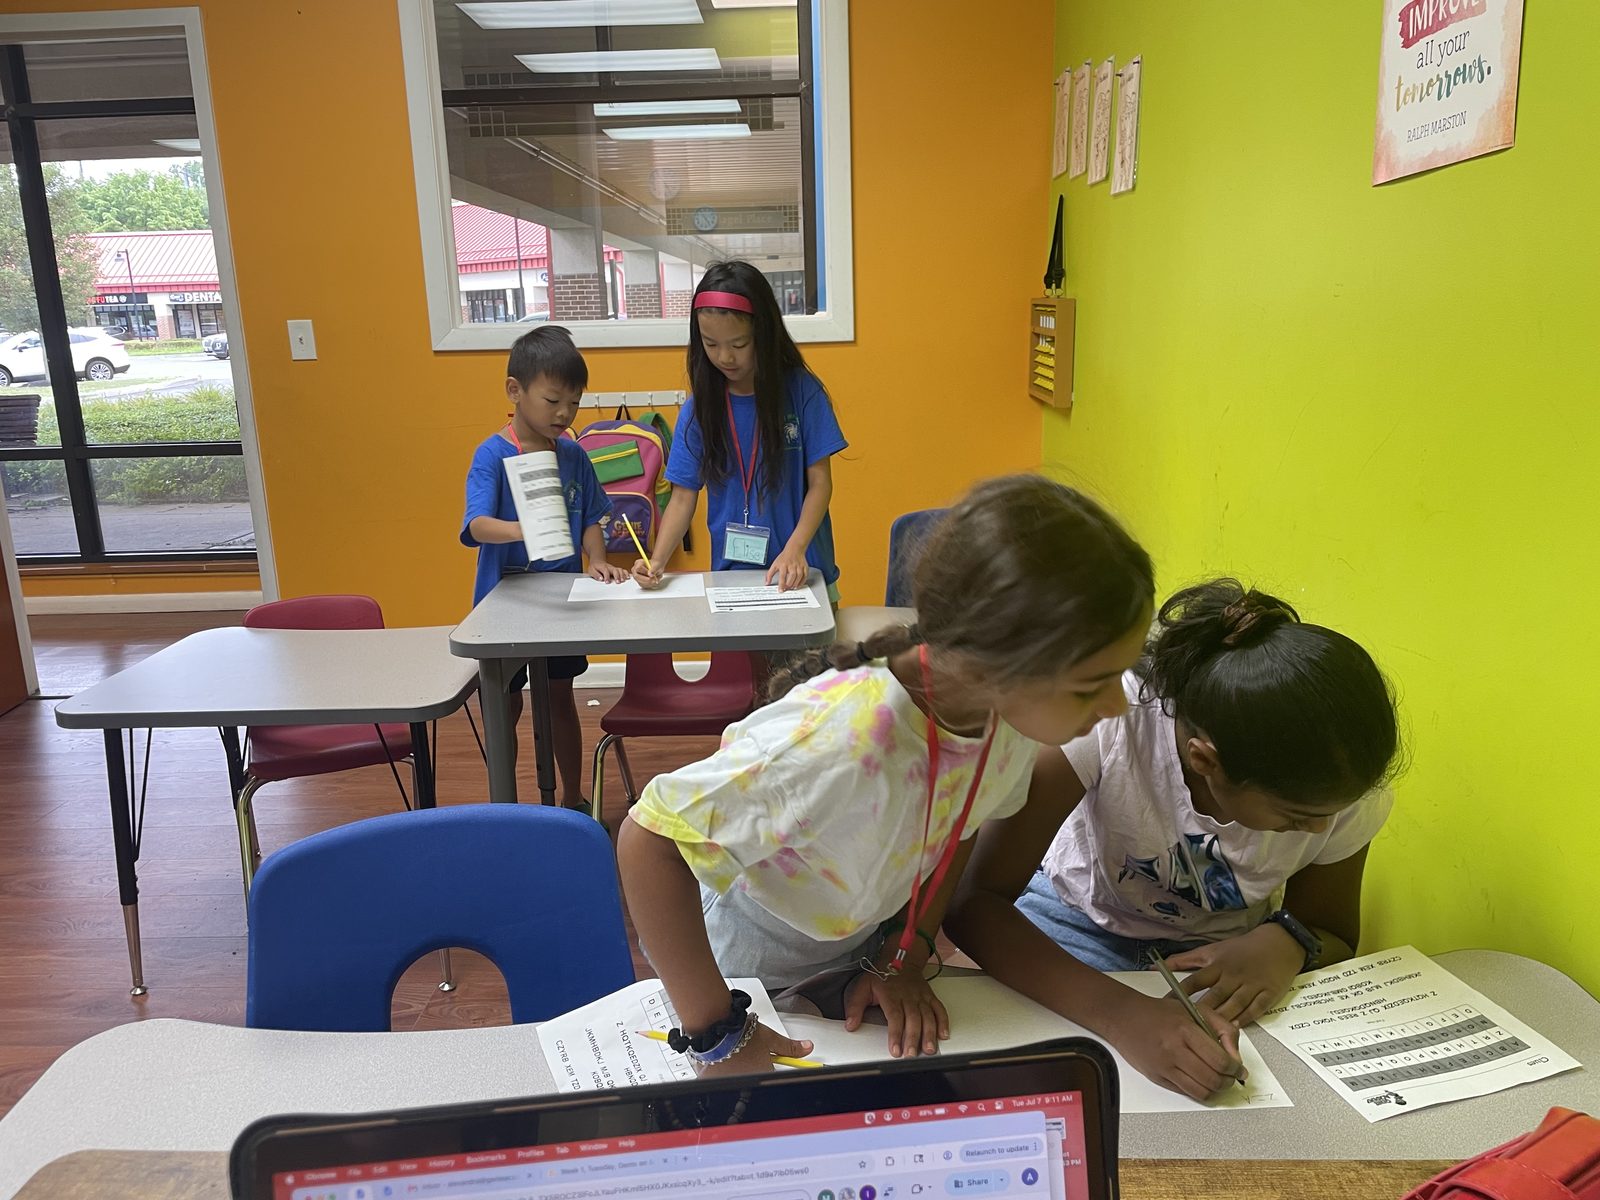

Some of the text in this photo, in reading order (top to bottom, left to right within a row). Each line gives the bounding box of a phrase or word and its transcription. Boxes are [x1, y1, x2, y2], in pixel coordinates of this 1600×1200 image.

[1417, 30, 1470, 69] all your
[1395, 54, 1492, 112] tomorrows.
[1406, 111, 1467, 142] RALPH MARSTON
[185, 292, 222, 302] DENTA
[1319, 974, 1340, 985] NQDH
[1342, 968, 1356, 978] TZD
[1352, 990, 1363, 998] QK
[1381, 993, 1429, 1010] HQTKQEDZIX
[1289, 1021, 1311, 1031] CZDX
[585, 1028, 603, 1064] JKMHBDKJ
[600, 1066, 610, 1078] MJB
[619, 1029, 642, 1073] HQTKQEDZIX
[555, 1040, 581, 1090] CZYRB XEM TZD
[1527, 1056, 1550, 1067] Clues
[428, 1159, 455, 1168] History
[466, 1153, 507, 1164] Bookmarks
[518, 1149, 545, 1159] Profiles
[580, 1143, 608, 1151] Window
[618, 1140, 635, 1148] Help
[965, 1147, 995, 1158] Relaunch
[1007, 1144, 1030, 1154] update
[967, 1177, 988, 1186] Share
[1027, 1173, 1033, 1181] A
